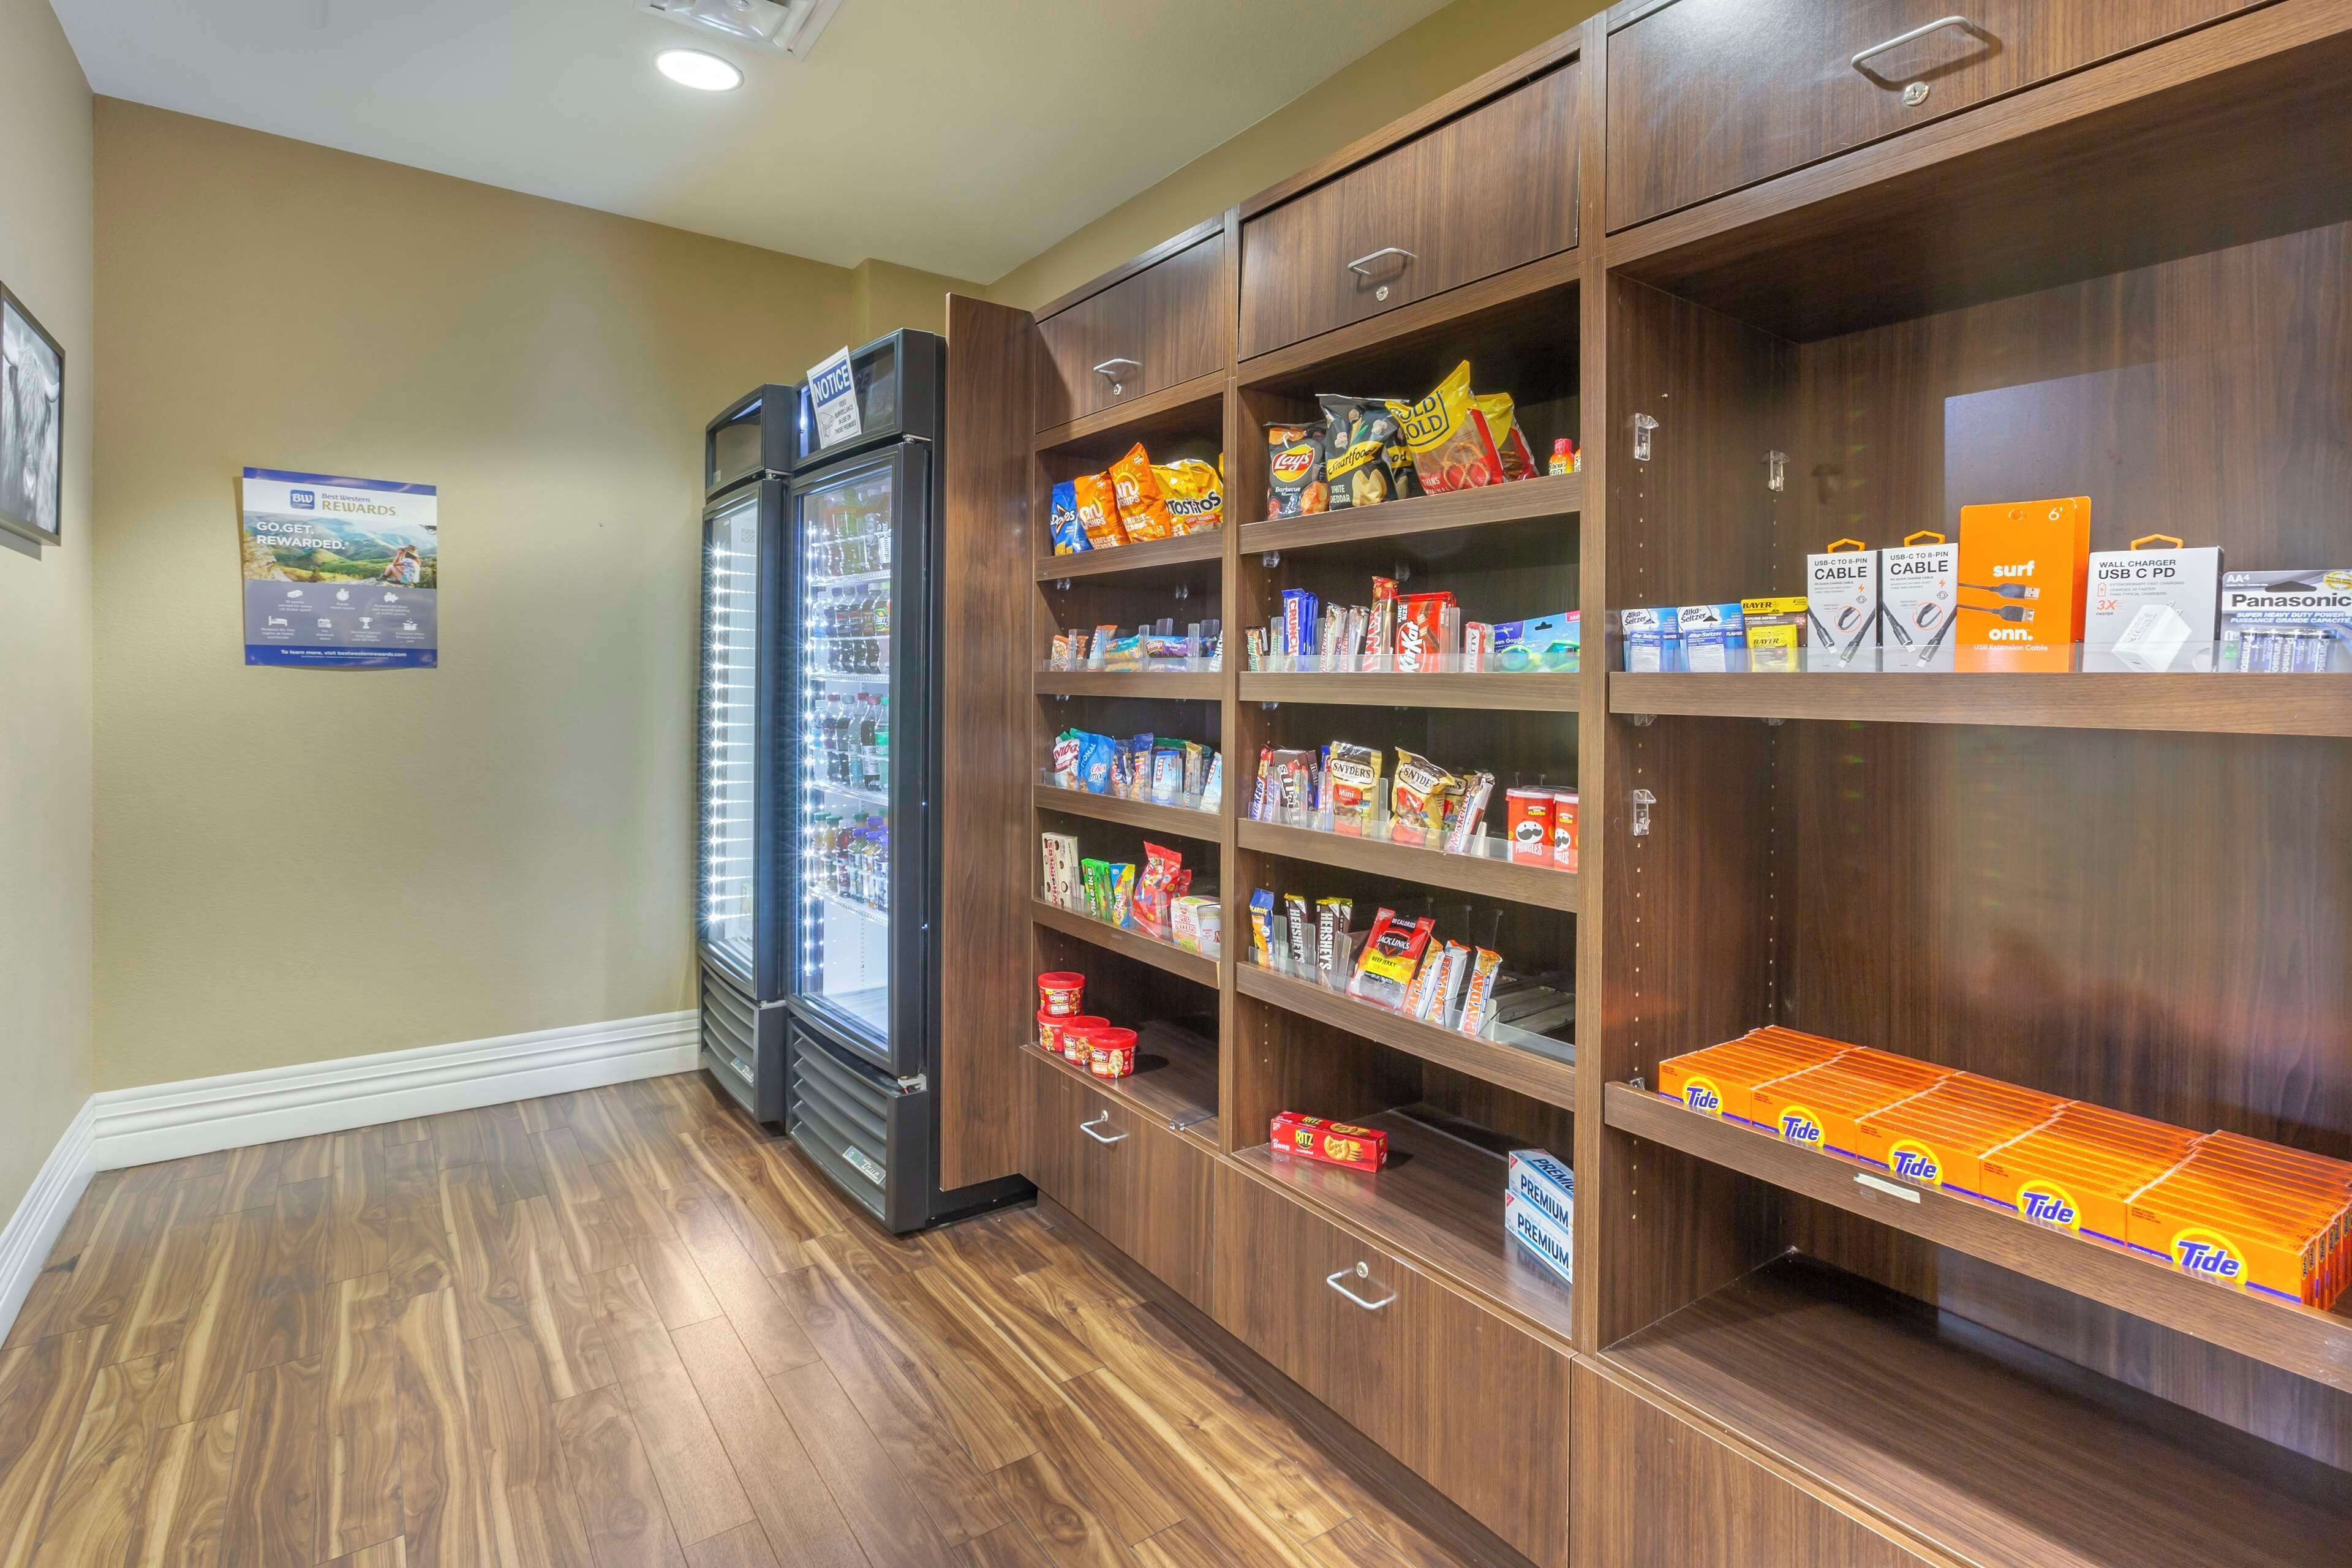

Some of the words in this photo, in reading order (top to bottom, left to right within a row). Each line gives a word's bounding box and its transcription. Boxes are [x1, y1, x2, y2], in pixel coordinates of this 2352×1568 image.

[813, 364, 850, 402] NOTICE
[1275, 450, 1310, 472] Lay's
[1422, 477, 1440, 486] THINS
[292, 493, 314, 503] BW
[322, 501, 396, 516] REWARDS
[257, 522, 314, 534] GO.GET.
[1087, 517, 1106, 528] CHIPS
[257, 535, 346, 550] REWARDED.
[1815, 567, 1867, 579] CABLE
[1891, 560, 1948, 575] CABLE
[1993, 560, 2035, 577] surf
[2098, 569, 2130, 579] USB
[2136, 568, 2147, 578] C
[2153, 568, 2175, 578] PD
[2097, 600, 2117, 610] 3X
[2232, 593, 2352, 607] Panasonic
[1681, 613, 1706, 623] Seltzer
[1682, 608, 1702, 616] Alka-
[1287, 599, 1299, 657] CRUNCH
[1624, 616, 1646, 625] Seltzer
[1989, 628, 2034, 641] onn.
[1333, 763, 1371, 778] SNYDER'S
[1404, 767, 1433, 788] SNYDE
[1338, 788, 1355, 797] Mini
[1515, 842, 1543, 856] PRINGLES
[1175, 921, 1196, 934] NOODLES
[1396, 919, 1416, 929] CALORIES
[1290, 908, 1305, 963] HERSHEY'S
[1319, 913, 1333, 970] HERSHEY'S
[1377, 935, 1392, 945] JACK
[1392, 938, 1411, 951] LINK'S
[1382, 958, 1397, 967] JERKY
[1463, 971, 1483, 1035] PAYDAY
[1686, 1087, 1719, 1109] Tide
[1302, 1117, 1323, 1125] RITZ
[1782, 1116, 1820, 1141] Tide
[1295, 1129, 1313, 1145] RITZ
[1893, 1150, 1938, 1179] Tide
[1532, 1158, 1574, 1193] PREMIU
[1521, 1174, 1569, 1228] PREMIUM
[2022, 1191, 2075, 1223] Tide
[1518, 1212, 1569, 1269] PREMIUM
[2177, 1240, 2240, 1276] Tide
